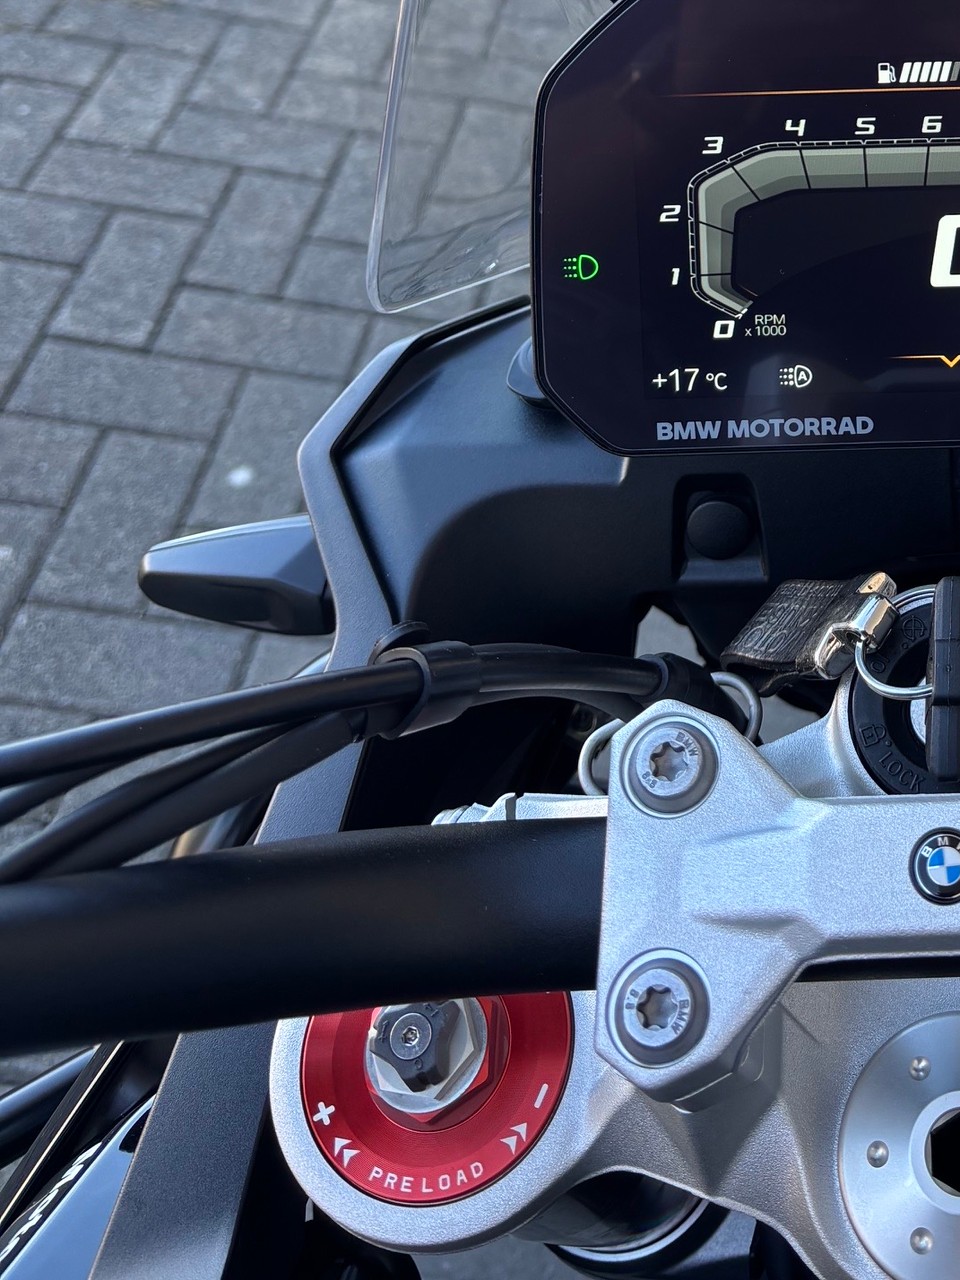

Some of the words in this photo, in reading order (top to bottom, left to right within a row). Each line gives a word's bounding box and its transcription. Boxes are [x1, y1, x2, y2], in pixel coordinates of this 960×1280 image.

[785, 118, 807, 137] 4
[854, 117, 877, 135] 5
[921, 115, 943, 134] 6
[702, 136, 724, 155] 3
[659, 204, 682, 223] 2
[671, 267, 680, 286] 1
[713, 319, 736, 339] 0
[754, 314, 786, 325] RPM
[652, 367, 700, 392] +17
[656, 420, 722, 441] BMW
[727, 416, 876, 439] MOTORRAD
[878, 751, 926, 793] LOCK
[368, 1161, 484, 1193] PRELOAD
